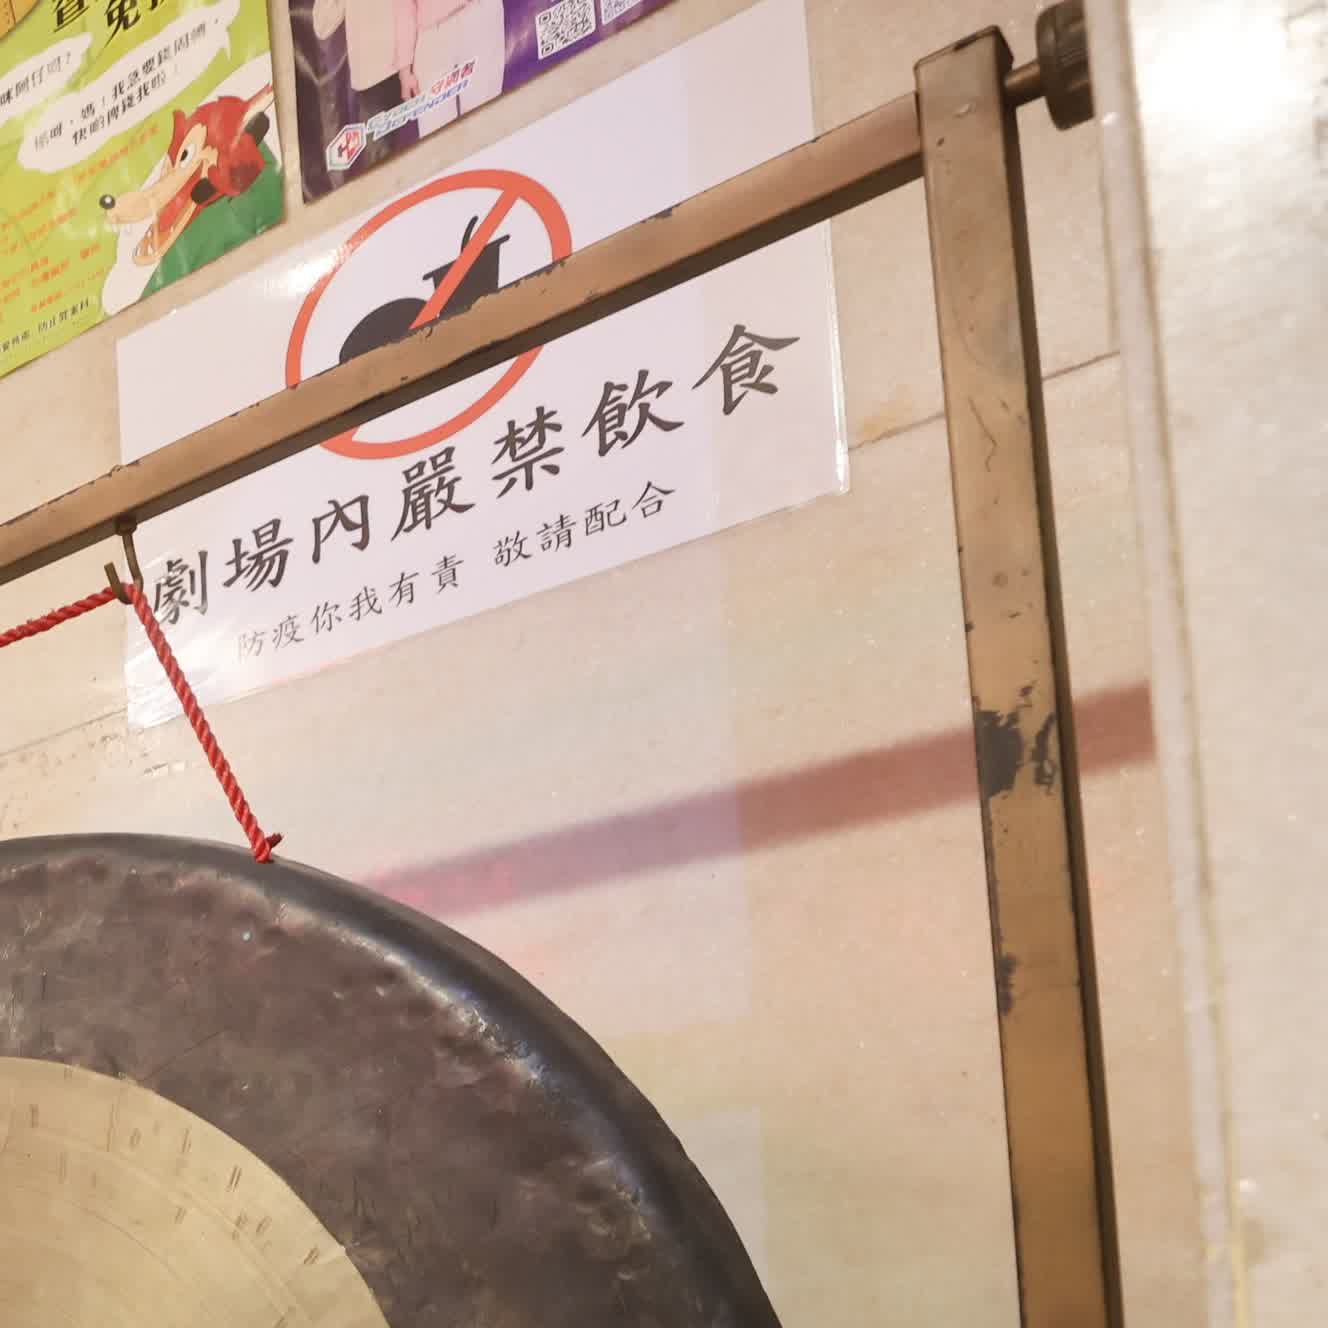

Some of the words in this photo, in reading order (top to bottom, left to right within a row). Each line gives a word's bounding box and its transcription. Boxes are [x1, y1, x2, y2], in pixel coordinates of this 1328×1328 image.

[151, 324, 800, 625] 劇場內嚴禁飲食
[237, 555, 465, 661] 防疫你我有責
[493, 480, 677, 568] 敬請配合
